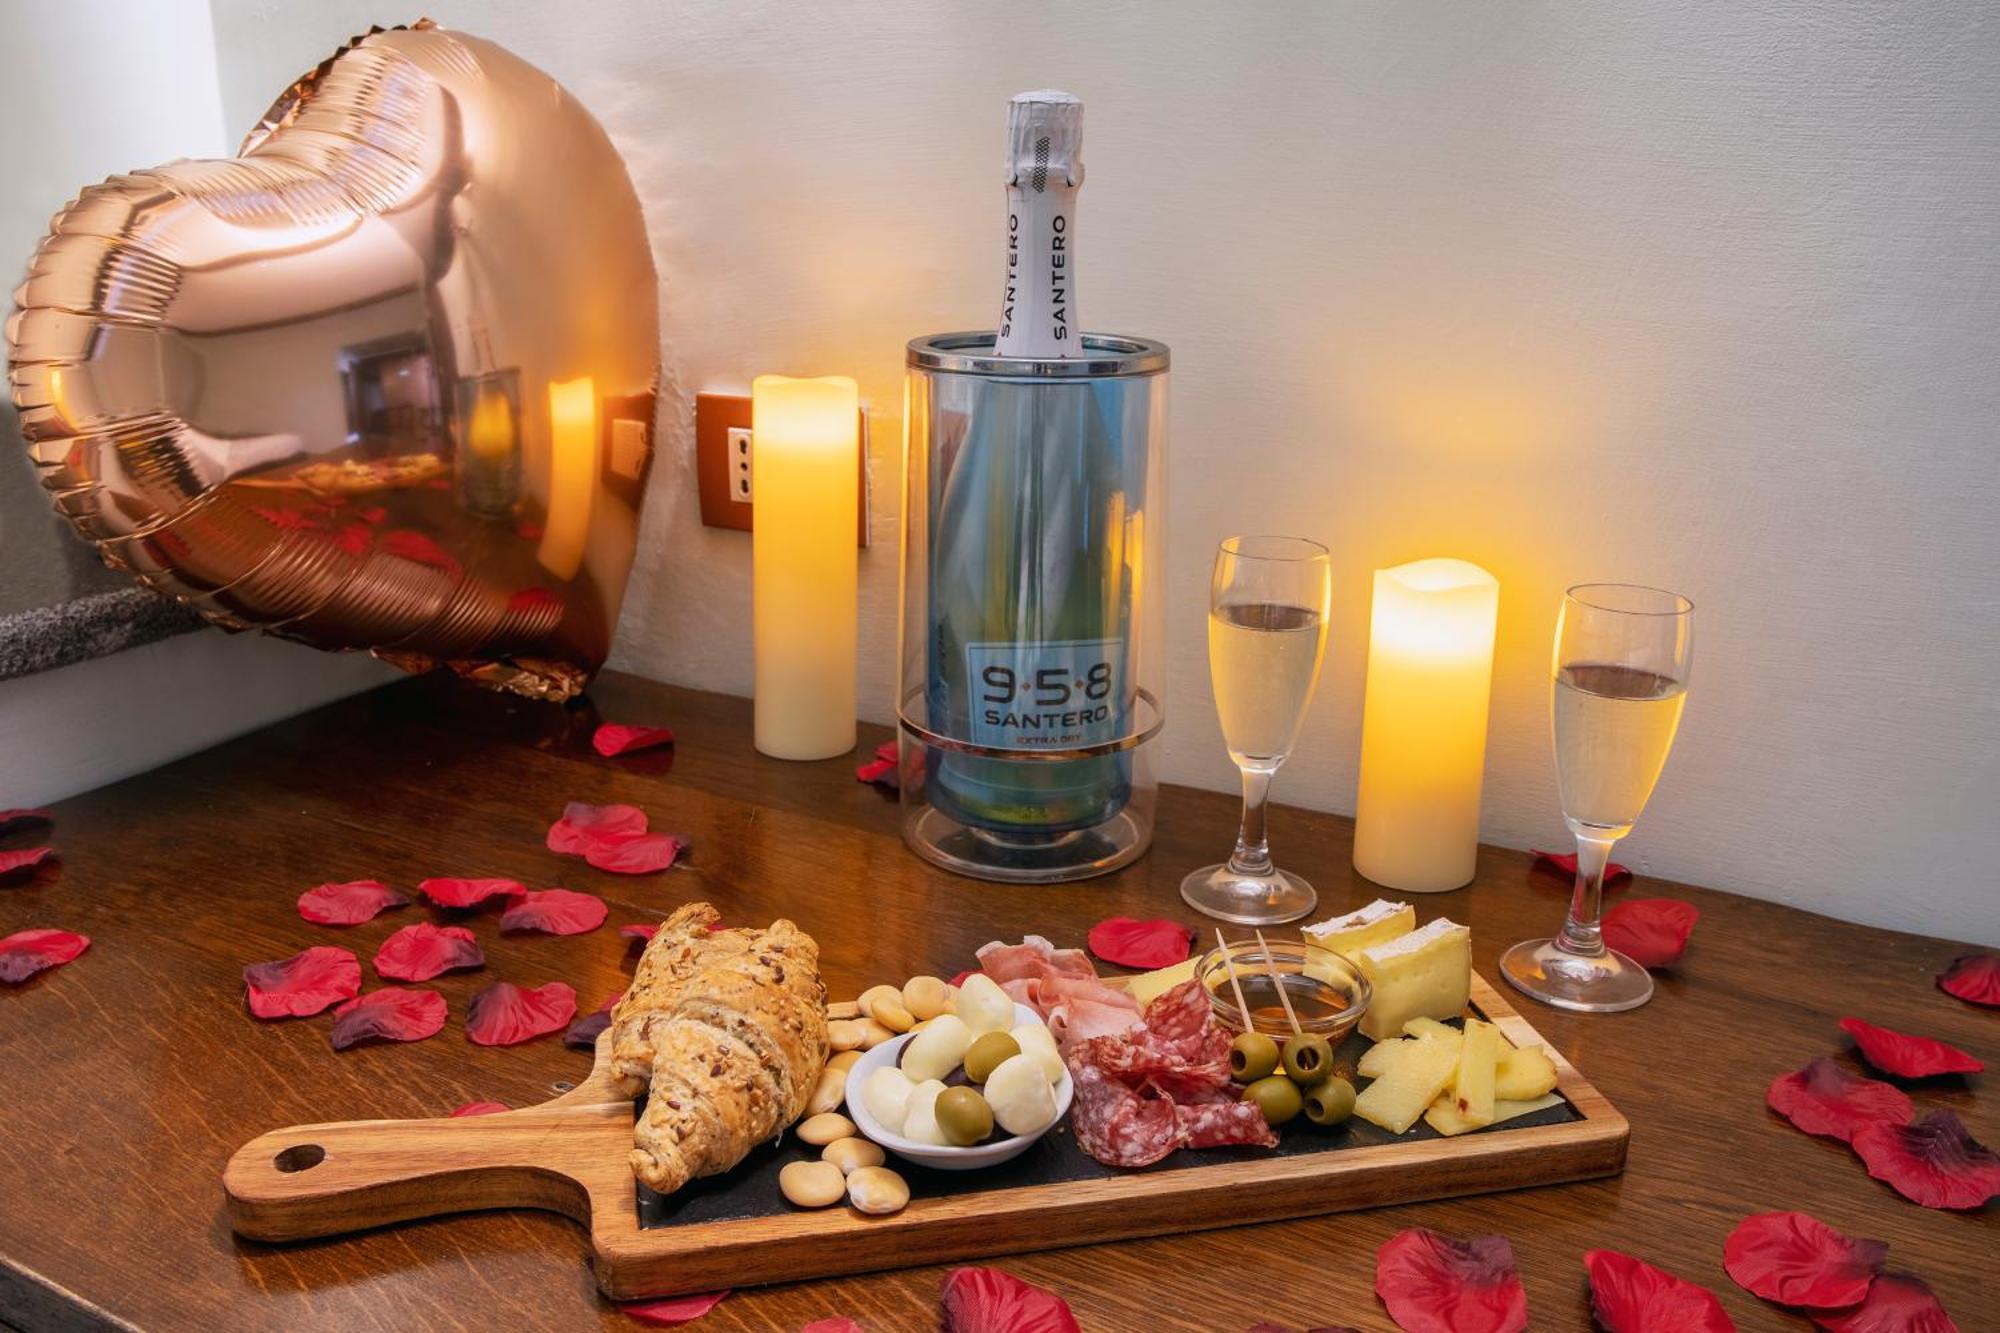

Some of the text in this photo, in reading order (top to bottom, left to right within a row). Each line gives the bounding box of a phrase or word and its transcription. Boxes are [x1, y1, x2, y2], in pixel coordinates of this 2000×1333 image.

[1001, 213, 1018, 338] SANTERO
[1052, 215, 1067, 341] SANTERO
[985, 705, 1108, 729] SANTERO
